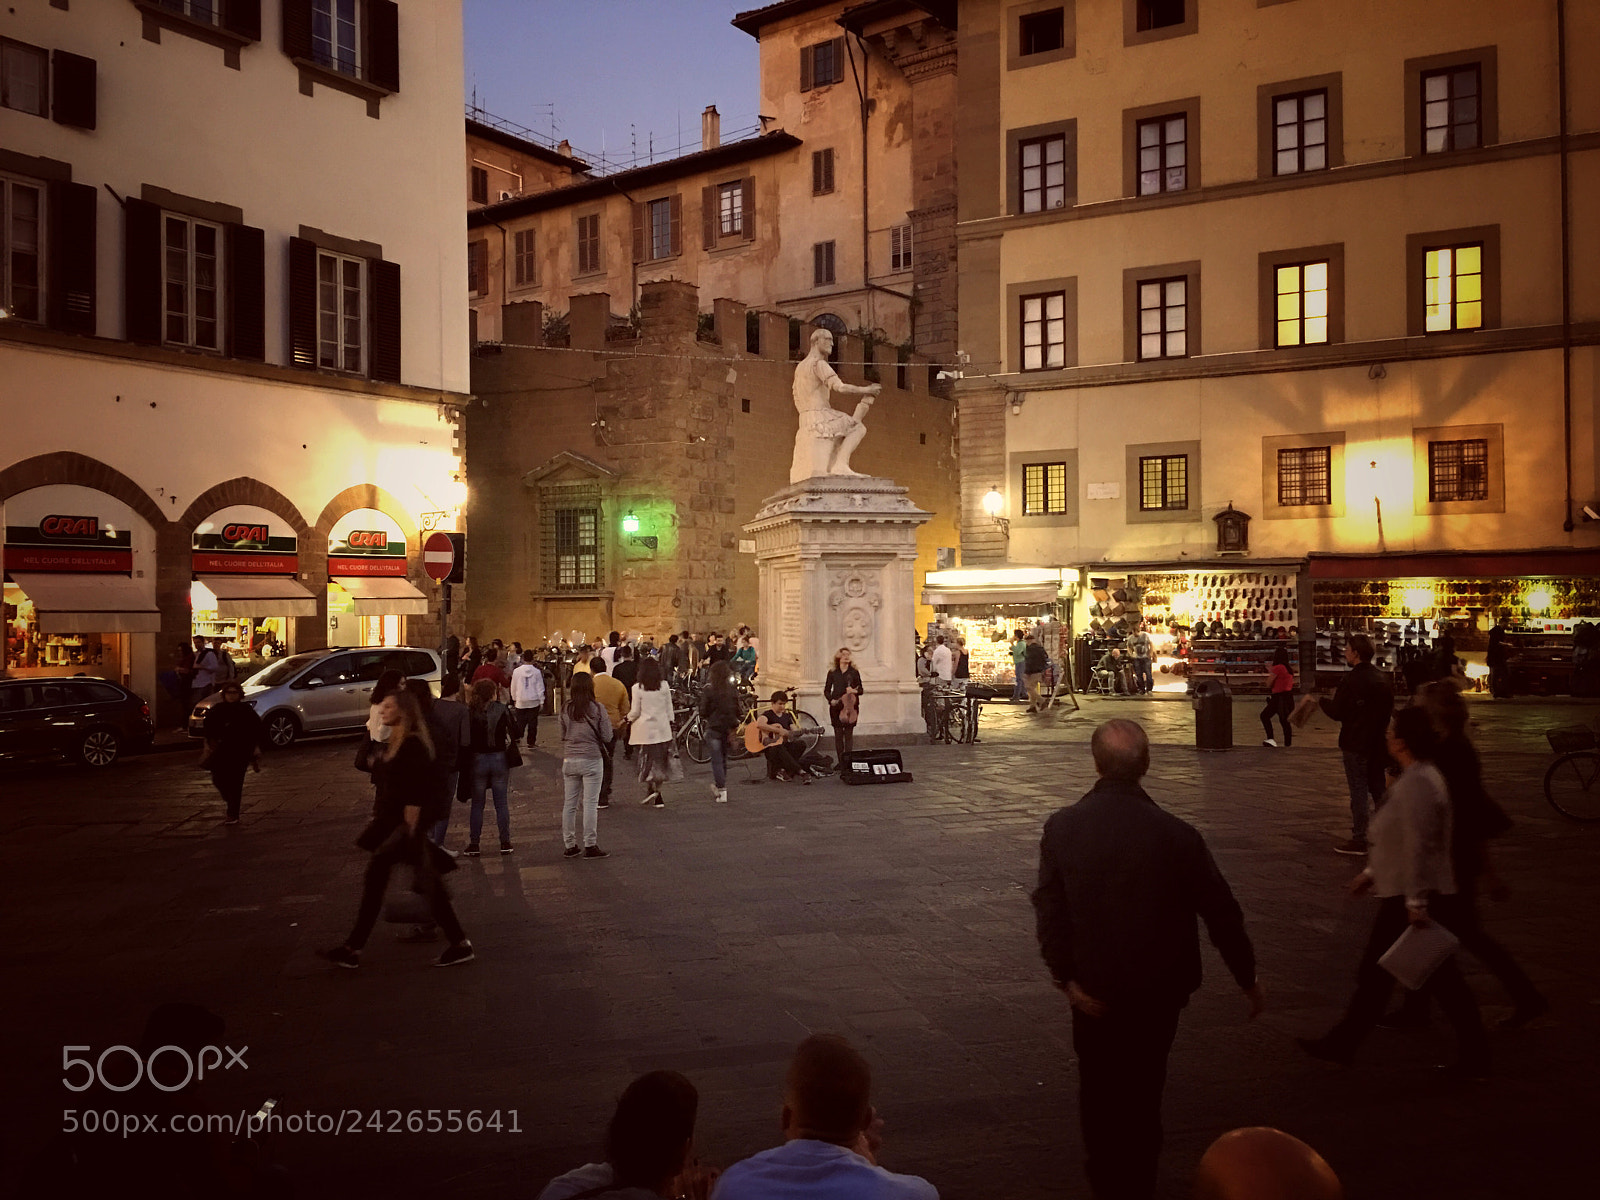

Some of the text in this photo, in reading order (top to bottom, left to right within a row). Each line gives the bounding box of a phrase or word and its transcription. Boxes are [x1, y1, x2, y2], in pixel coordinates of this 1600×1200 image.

[43, 517, 96, 535] CRAI
[224, 525, 267, 541] CRAI
[350, 532, 386, 547] CRAI
